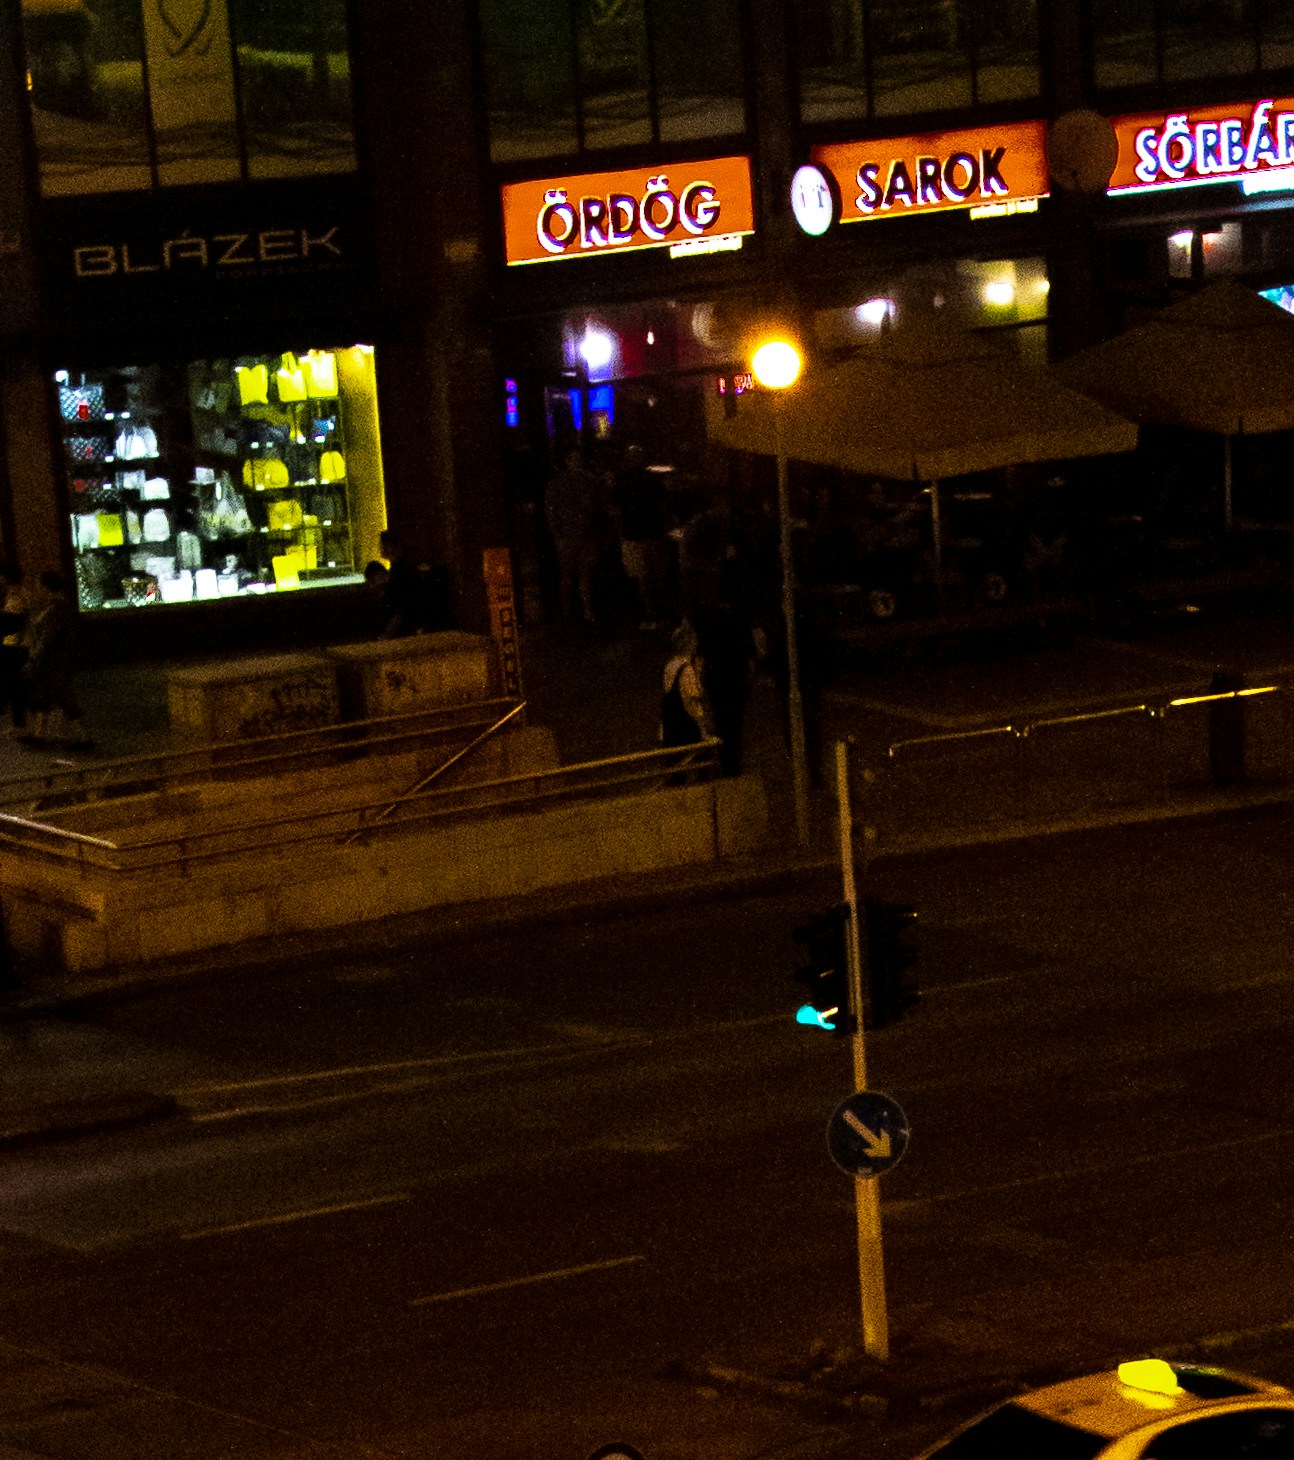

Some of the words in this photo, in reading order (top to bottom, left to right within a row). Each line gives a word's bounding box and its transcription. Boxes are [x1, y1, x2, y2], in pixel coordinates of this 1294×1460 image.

[536, 174, 721, 254] ÖRDÖG
[854, 146, 1009, 214] SAROK
[73, 227, 342, 277] BLÁZEK
